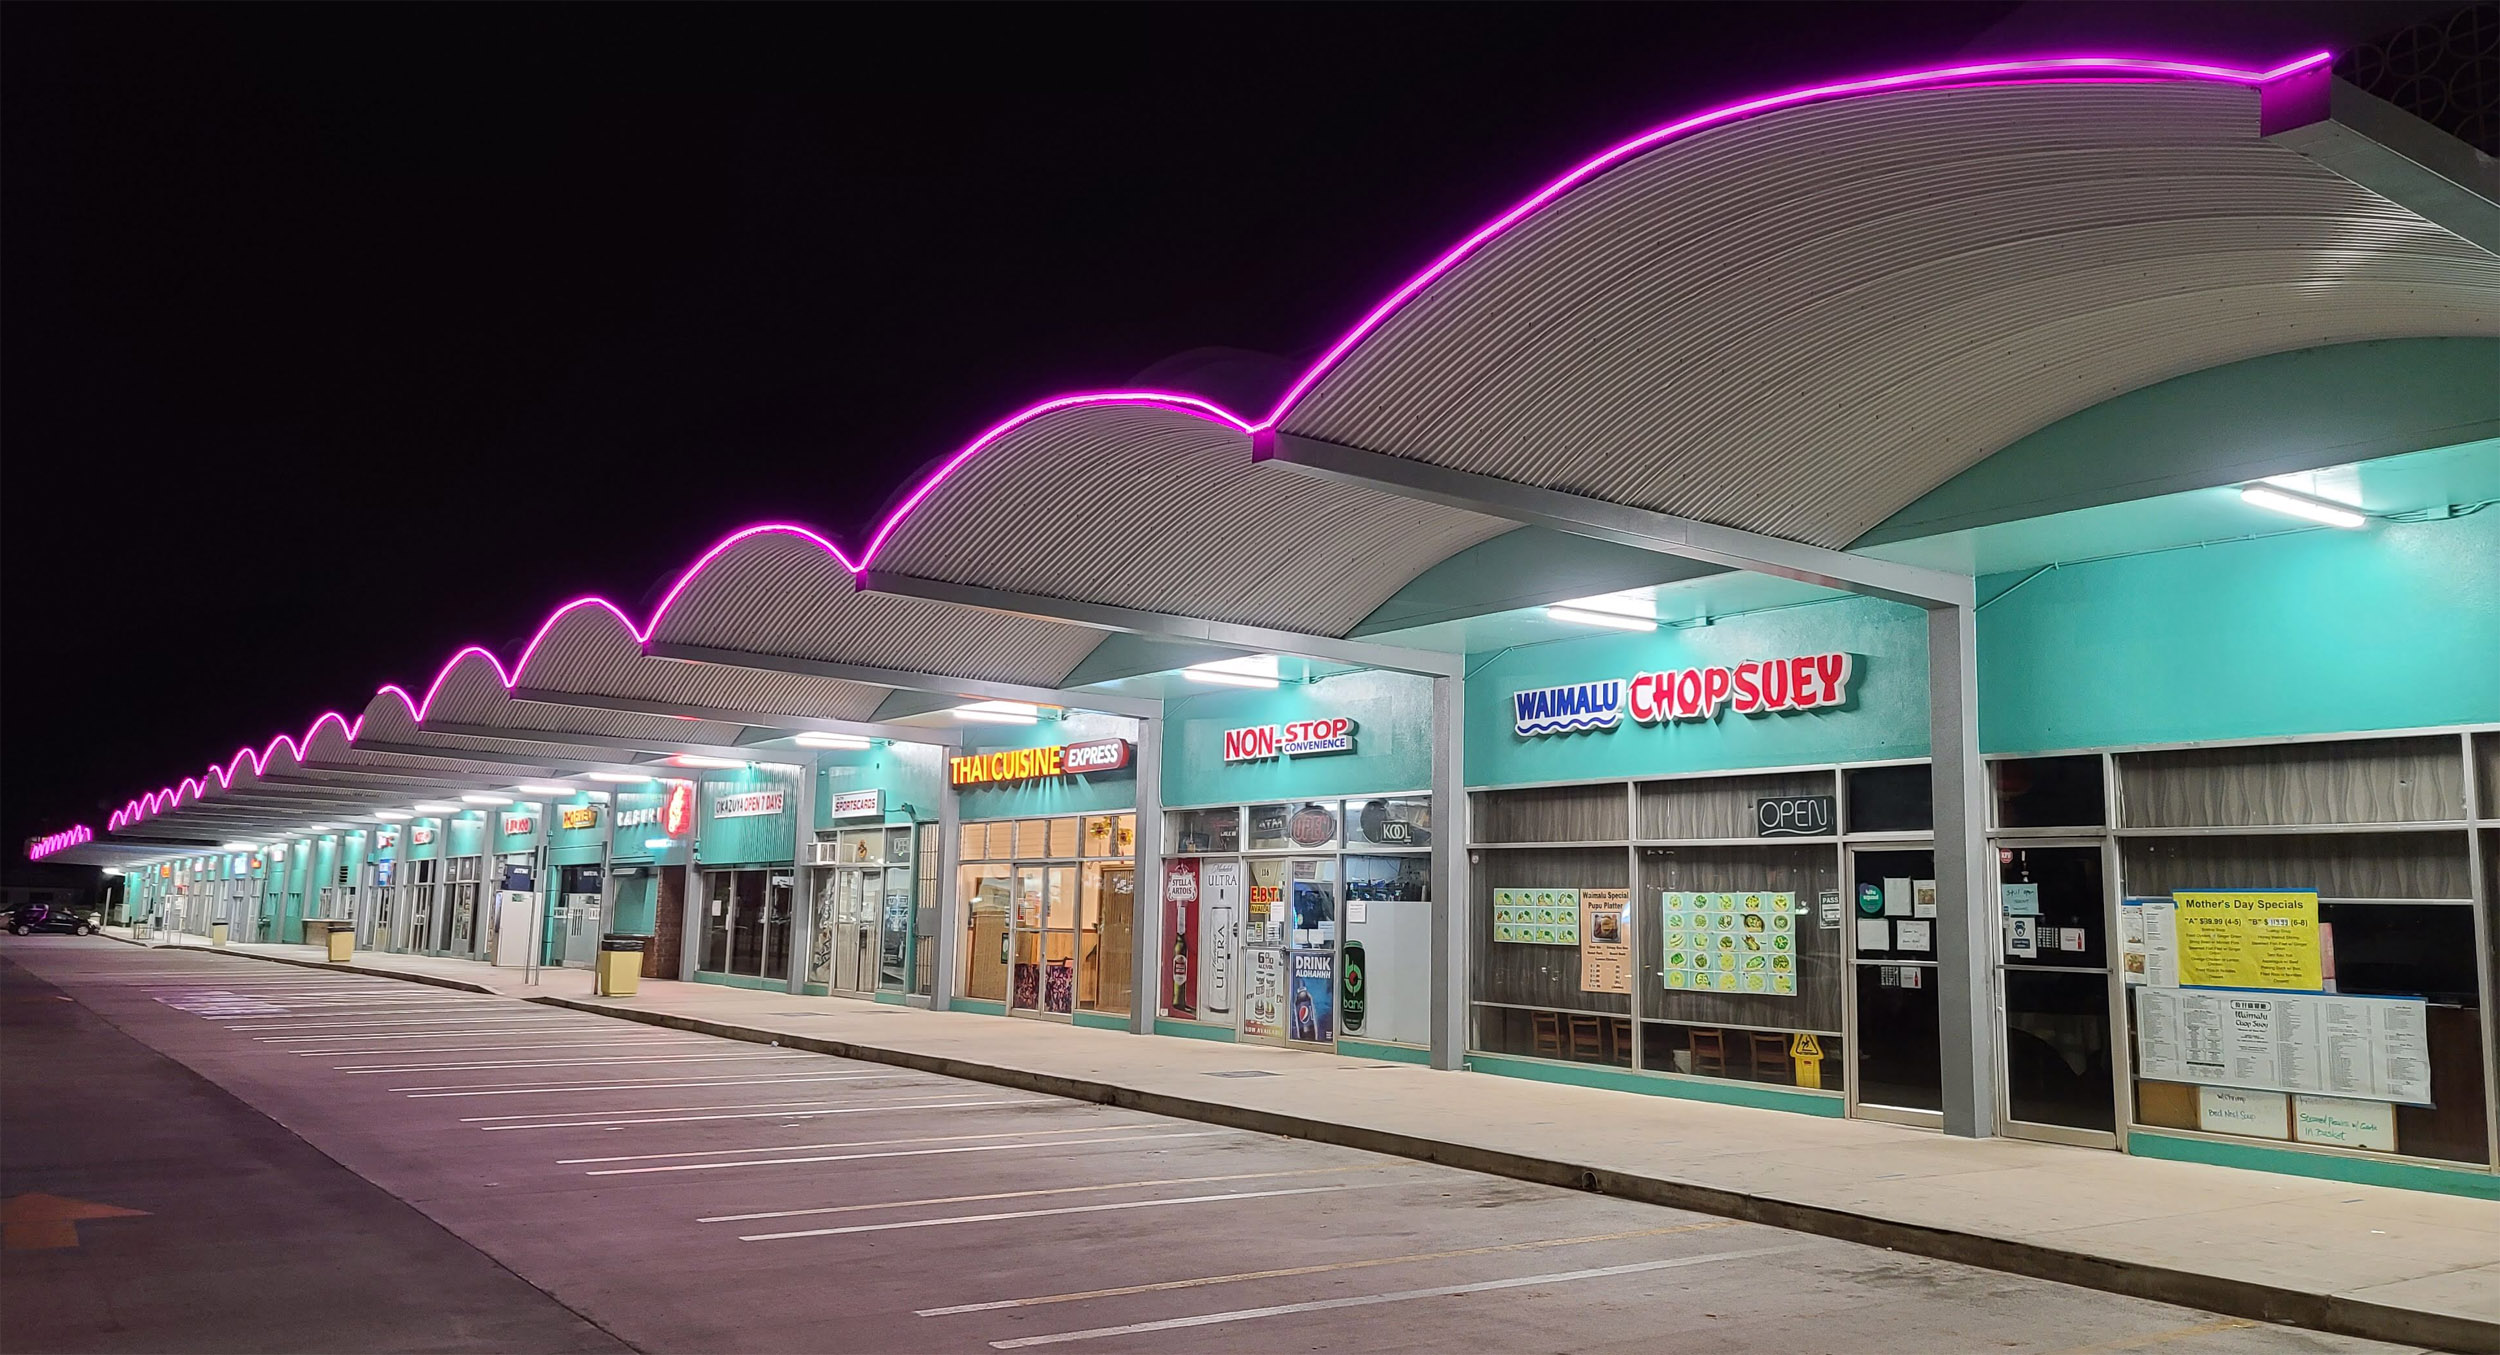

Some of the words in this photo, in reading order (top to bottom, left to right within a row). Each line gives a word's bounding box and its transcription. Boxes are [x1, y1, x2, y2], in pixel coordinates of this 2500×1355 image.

[1517, 682, 1618, 721] WAIMALU
[1630, 667, 1730, 722] CHOP
[1733, 654, 1843, 711] SUEY
[1284, 738, 1345, 752] CONVENIENCE
[950, 755, 987, 784] THAI
[991, 745, 1061, 781] CUISINE
[1068, 743, 1119, 767] EXPRESS
[716, 799, 743, 814] OKAZUYA
[744, 797, 760, 812] OPEN
[761, 796, 765, 811] 7
[766, 794, 782, 810] DAYS
[834, 798, 876, 812] SPORTSCARDS
[1759, 799, 1828, 828] OPEN
[1258, 816, 1283, 829] ATM
[1294, 814, 1331, 842] OPEN
[1383, 823, 1412, 840] KOOL
[1172, 879, 1192, 887] STELLA
[1208, 875, 1237, 886] ULTRA
[1171, 886, 1192, 895] ARTOIS
[1608, 891, 1629, 900] Special
[1588, 902, 1602, 910] Pupu
[1603, 902, 1623, 910] Platter
[1822, 896, 1839, 904] PASS
[2186, 899, 2230, 909] Mother's
[2234, 900, 2254, 910] Day
[2257, 900, 2304, 910] Specials
[2224, 918, 2242, 927] (4-5)
[1216, 925, 1225, 989] ULTRA
[1295, 955, 1331, 971] DRINK
[1343, 997, 1364, 1013] bang
